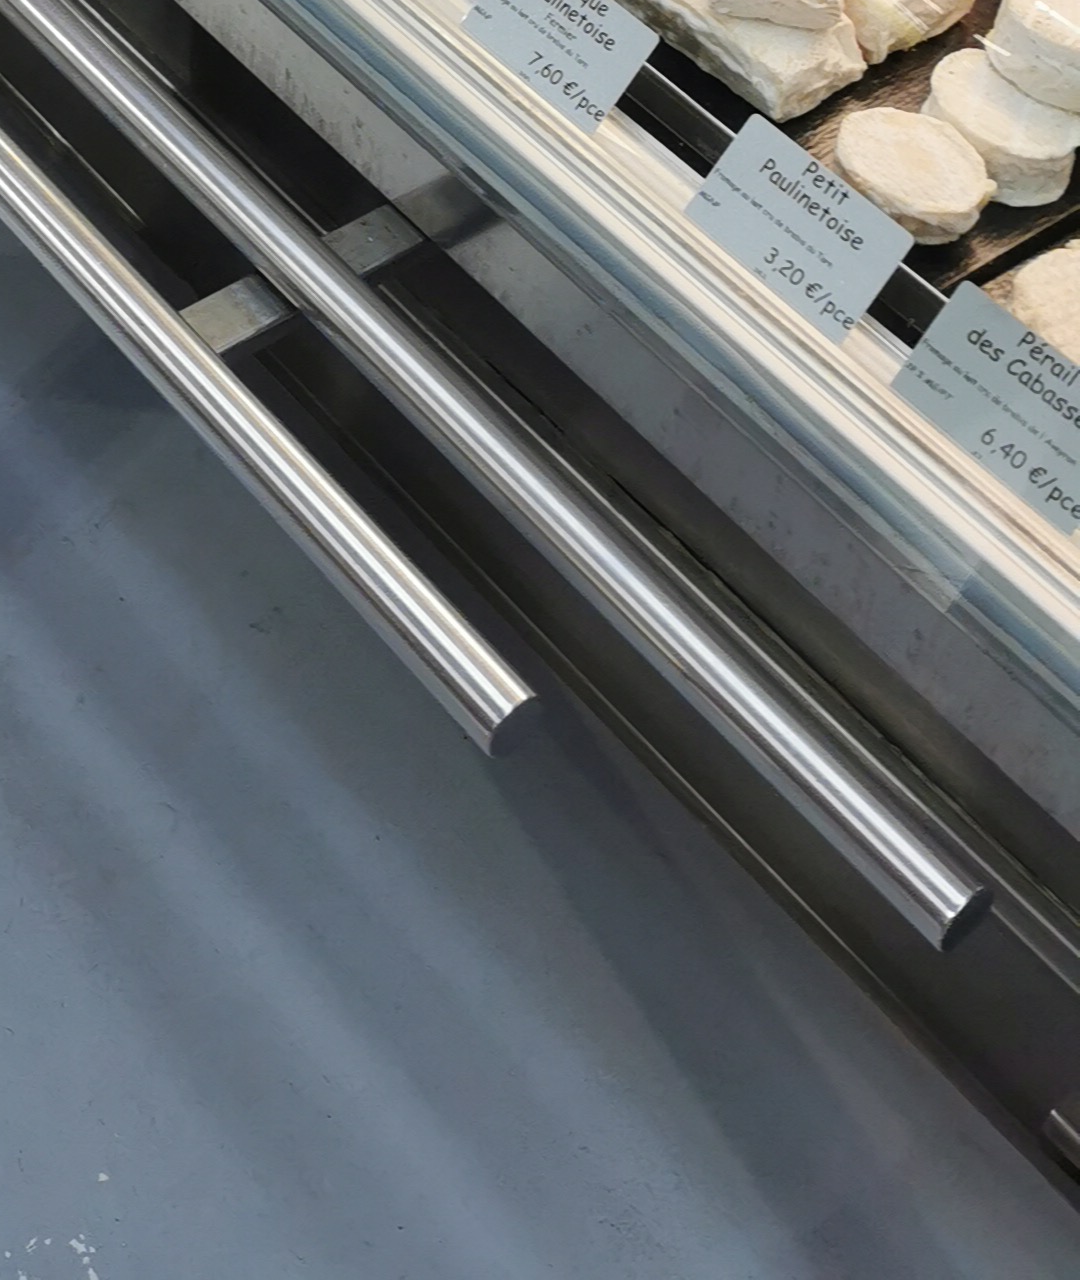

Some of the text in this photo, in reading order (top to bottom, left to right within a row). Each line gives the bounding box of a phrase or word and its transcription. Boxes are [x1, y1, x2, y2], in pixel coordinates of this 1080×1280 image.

[544, 12, 578, 42] Fermier
[528, 50, 606, 123] 7,60 €/pce
[758, 157, 865, 251] Paulinetoise
[801, 161, 850, 206] Petit
[763, 246, 857, 331] 3,20 €/pce
[966, 328, 1080, 430] des Cabasse
[1016, 330, 1080, 388] Pérail
[980, 427, 1080, 520] 6,40 €/pce
